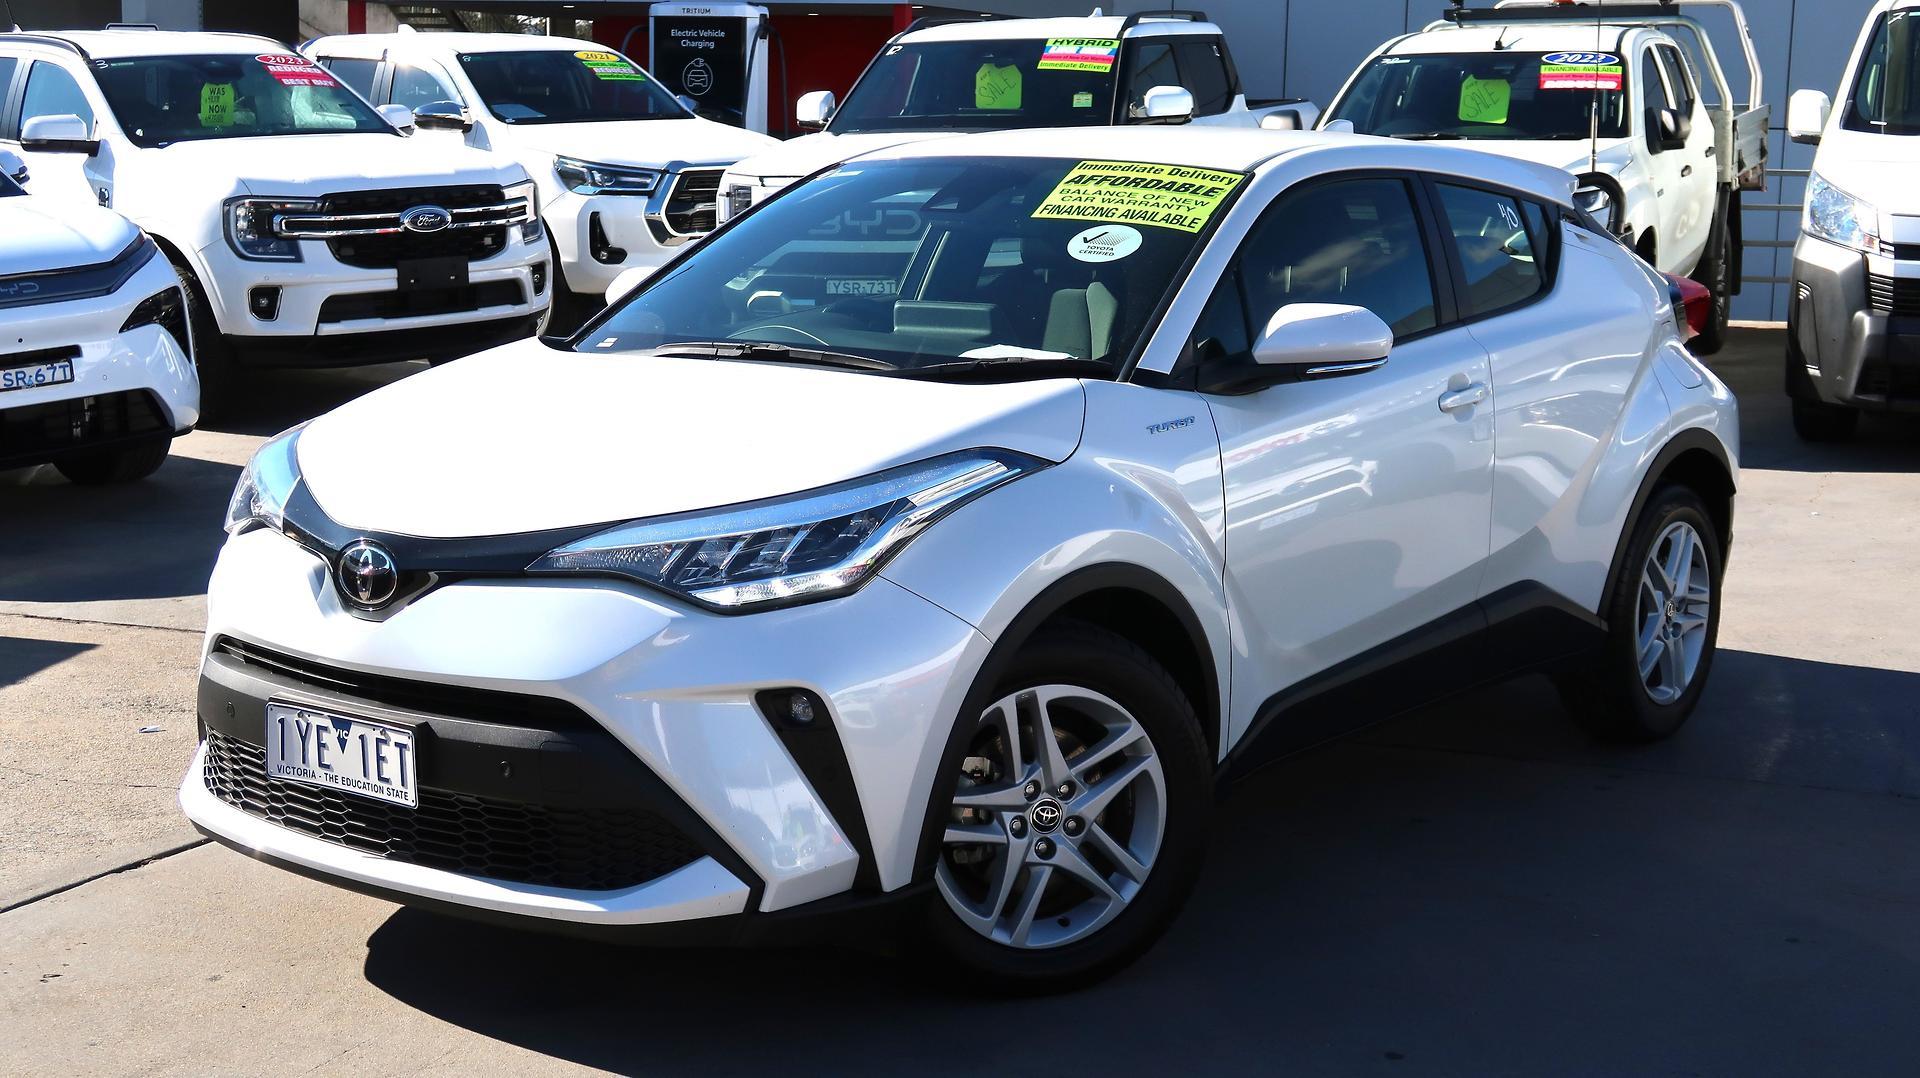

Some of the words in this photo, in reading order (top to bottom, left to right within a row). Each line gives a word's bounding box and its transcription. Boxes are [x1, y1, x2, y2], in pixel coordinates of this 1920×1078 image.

[671, 29, 698, 37] Electric
[699, 29, 725, 37] Vehicle
[681, 40, 715, 48] Charging
[1053, 39, 1115, 47] HYBRID
[267, 56, 304, 65] 2023
[584, 52, 610, 60] 2021
[1553, 53, 1607, 63] 2022
[209, 87, 226, 96] WAS
[208, 104, 227, 114] NOW
[1078, 162, 1164, 175] Immediate
[1167, 167, 1238, 186] Delivery
[1063, 174, 1226, 198] AFFORDABLE
[1060, 188, 1139, 199] BALANCE
[1143, 193, 1167, 201] OF
[1170, 196, 1210, 208] NEW
[1101, 197, 1196, 213] WARRANTY
[1039, 204, 1119, 219] FINANCING
[1117, 208, 1202, 229] AVAILABLE
[1078, 249, 1115, 257] CERTIFIED
[336, 728, 349, 739] VIC
[277, 717, 332, 770] 1YE
[358, 734, 409, 788] 1ET
[277, 764, 317, 779] VICTORIA
[324, 772, 339, 784] THE
[341, 776, 385, 795] EDUCATION
[386, 787, 409, 801] STATE
